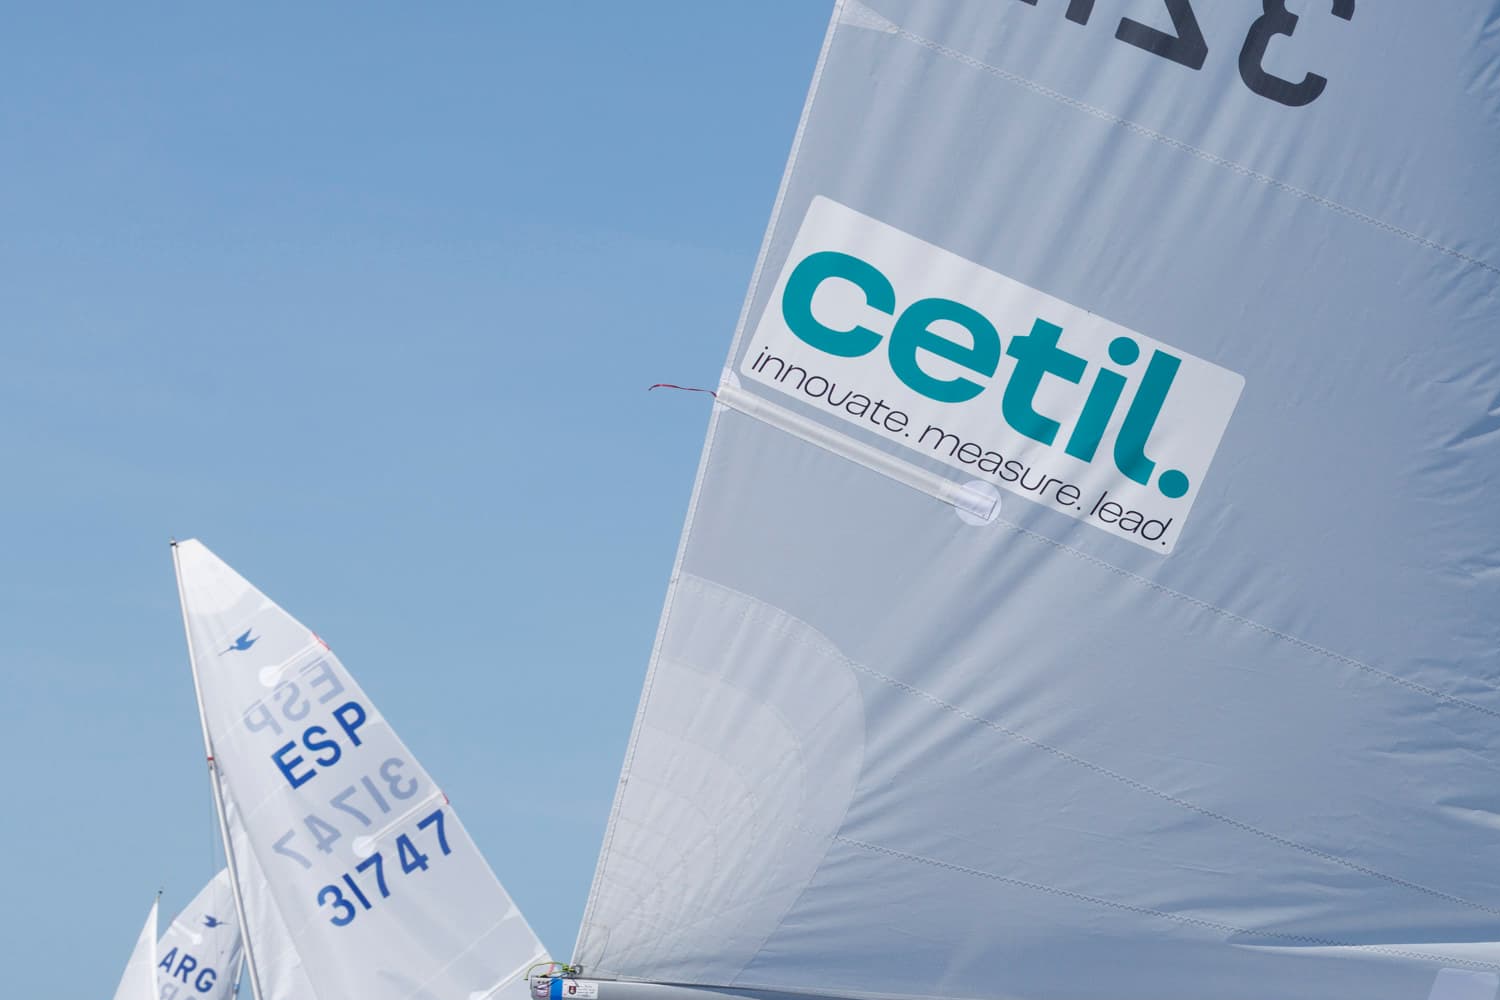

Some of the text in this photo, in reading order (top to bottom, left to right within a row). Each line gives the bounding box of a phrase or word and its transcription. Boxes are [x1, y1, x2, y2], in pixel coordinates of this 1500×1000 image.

[781, 251, 1190, 499] cetil.
[751, 346, 1173, 546] innovate. measure. lead.
[272, 700, 367, 789] ESP
[317, 809, 454, 927] 31747
[158, 946, 217, 993] ARG
